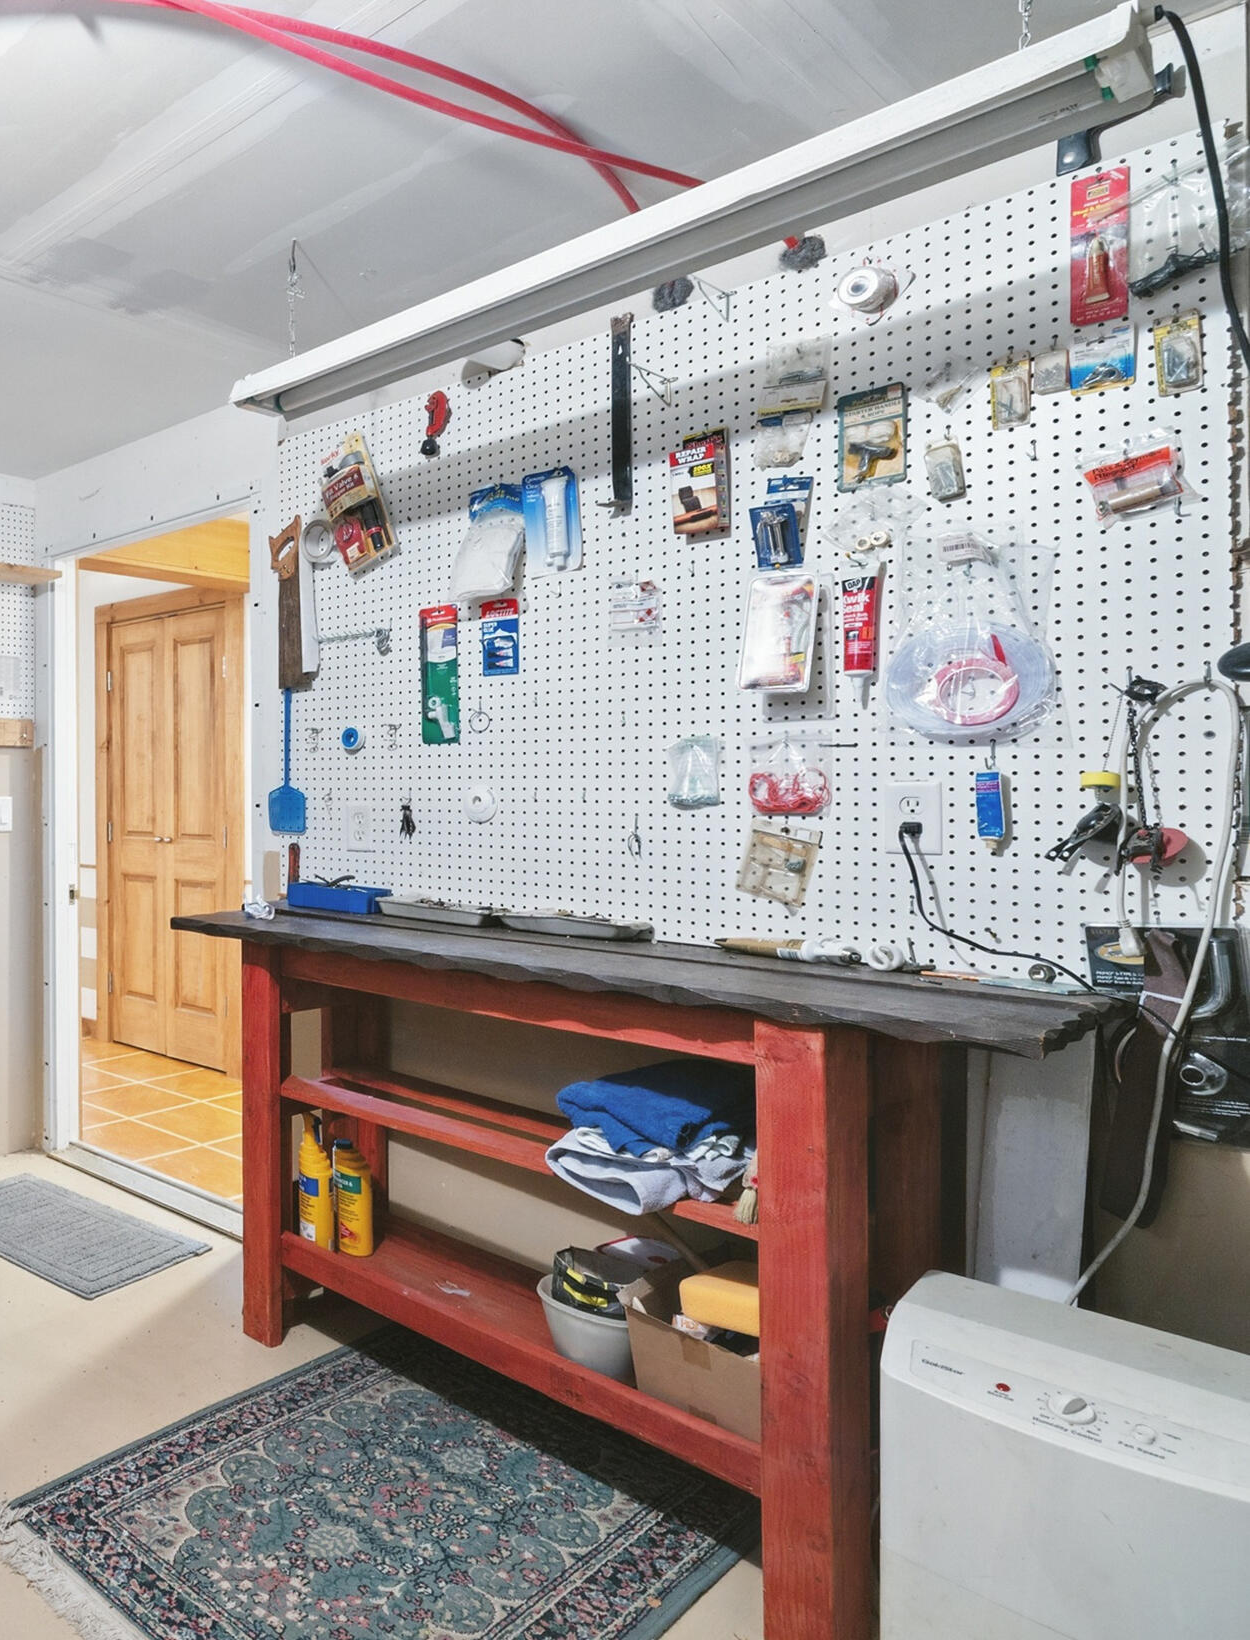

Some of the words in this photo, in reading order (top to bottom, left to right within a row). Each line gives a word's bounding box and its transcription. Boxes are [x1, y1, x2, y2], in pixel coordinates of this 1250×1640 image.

[675, 446, 707, 459] REPAIR
[677, 453, 705, 465] WRAP
[334, 478, 352, 492] Valve
[847, 579, 861, 590] DAP
[485, 608, 514, 619] LOCTITE
